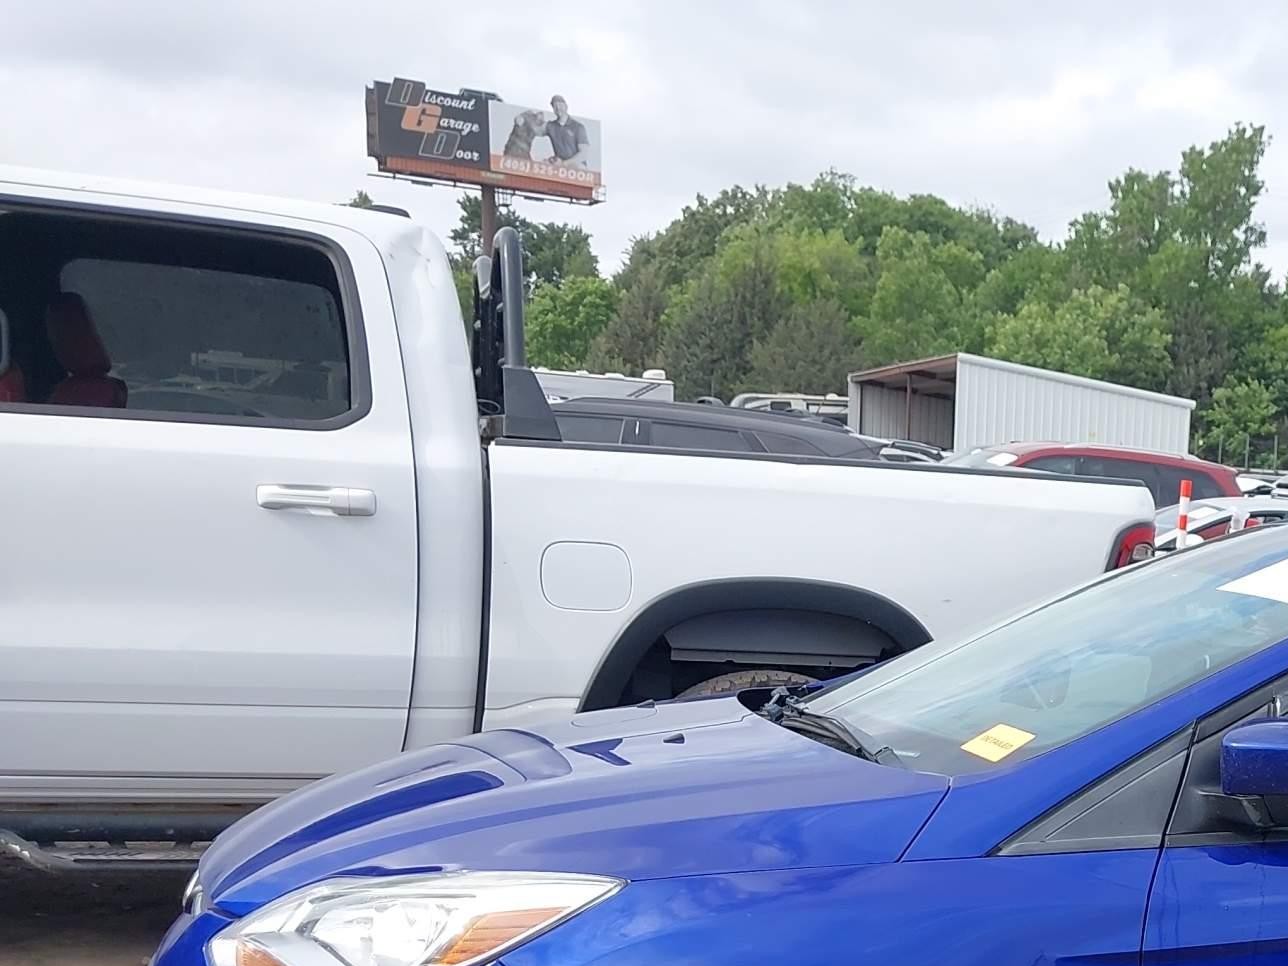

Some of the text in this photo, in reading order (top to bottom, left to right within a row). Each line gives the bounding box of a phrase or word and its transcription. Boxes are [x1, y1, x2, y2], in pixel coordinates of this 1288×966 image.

[385, 77, 476, 111] Discount
[401, 105, 480, 133] Garage
[419, 130, 480, 160] Door
